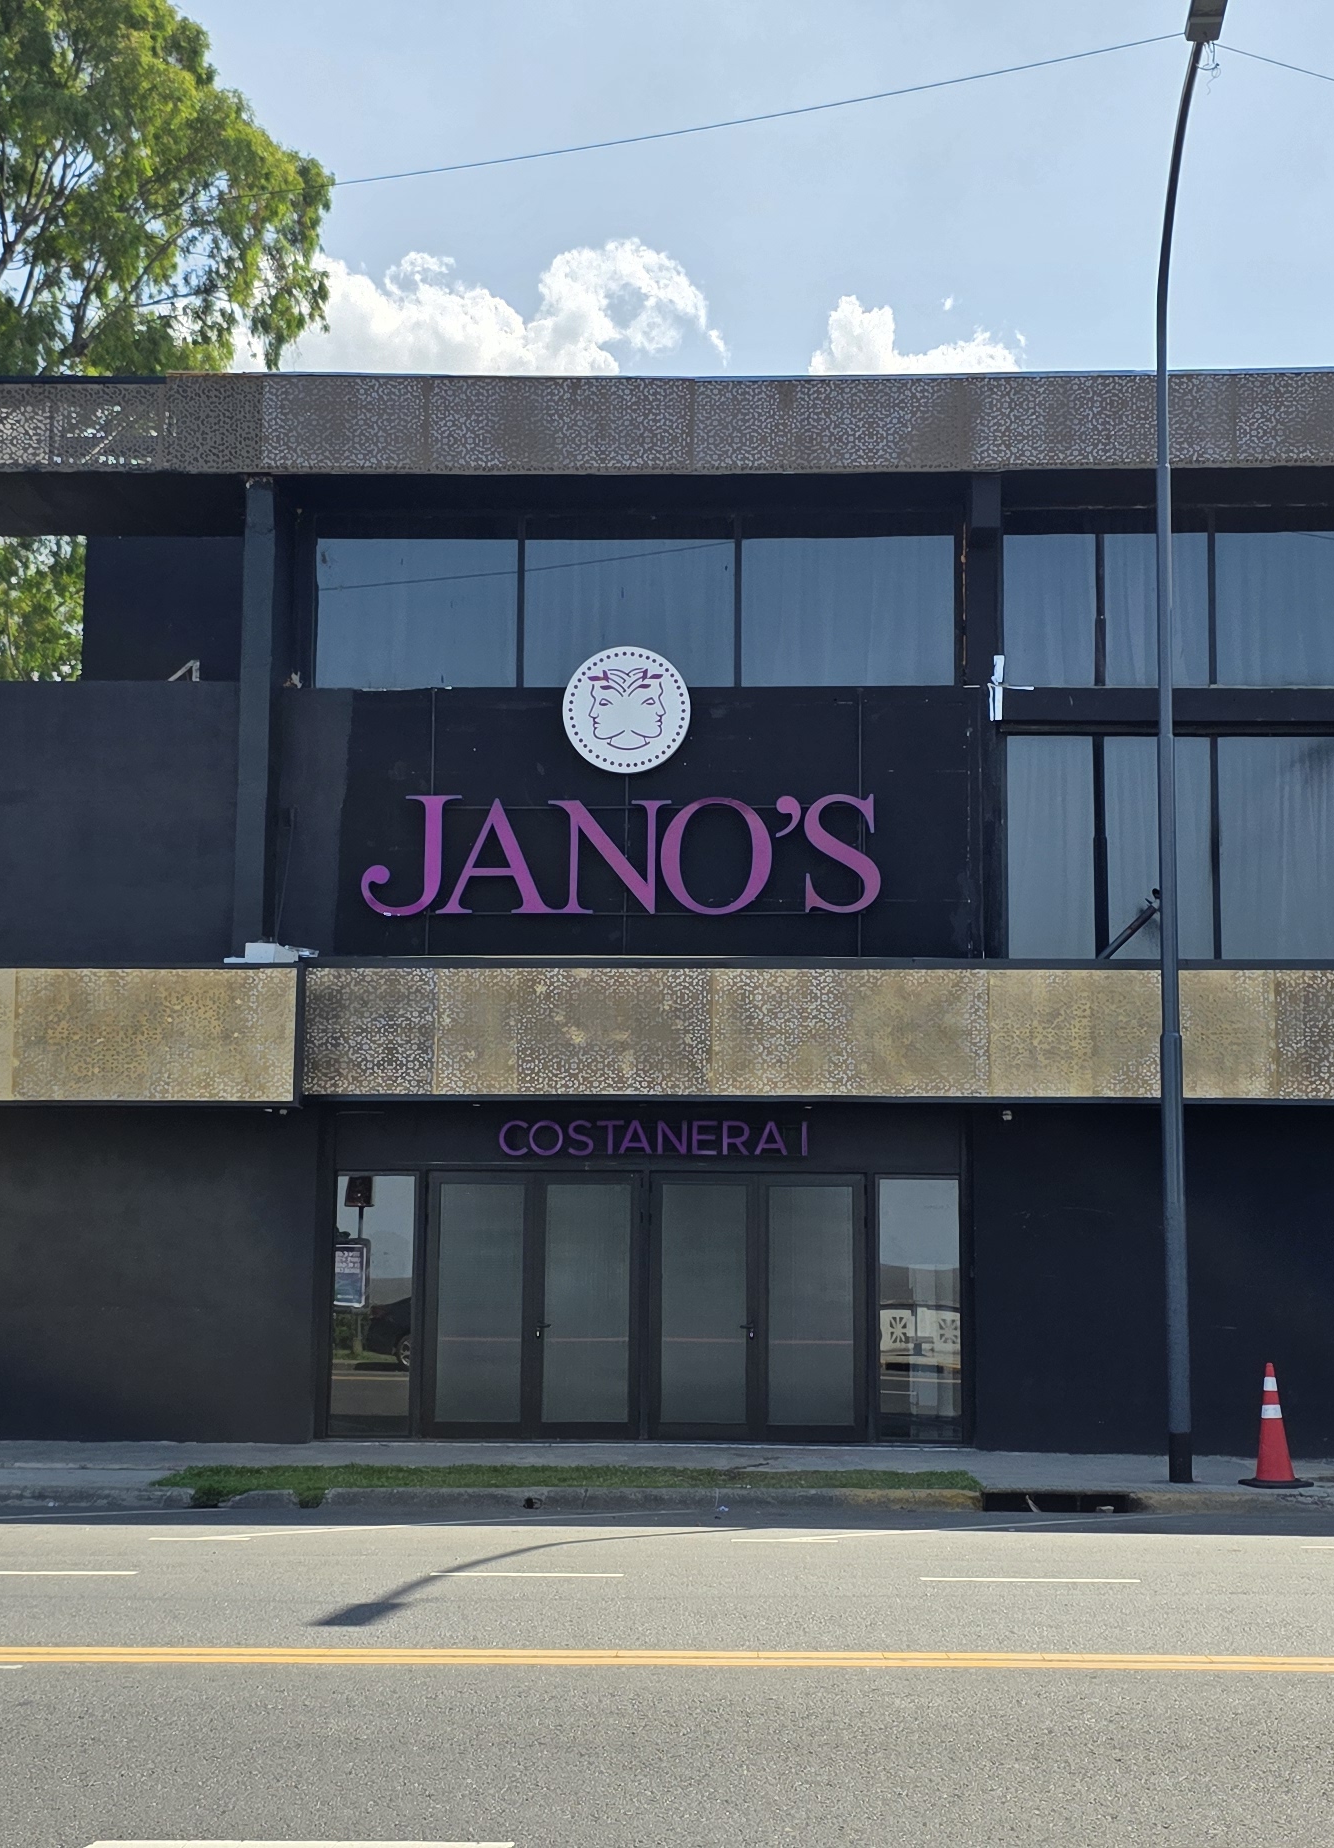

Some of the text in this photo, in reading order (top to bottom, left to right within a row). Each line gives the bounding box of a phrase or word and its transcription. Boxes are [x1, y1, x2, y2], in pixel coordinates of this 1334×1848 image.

[360, 793, 882, 916] JANO'S
[499, 1120, 808, 1156] COSTANERA I
